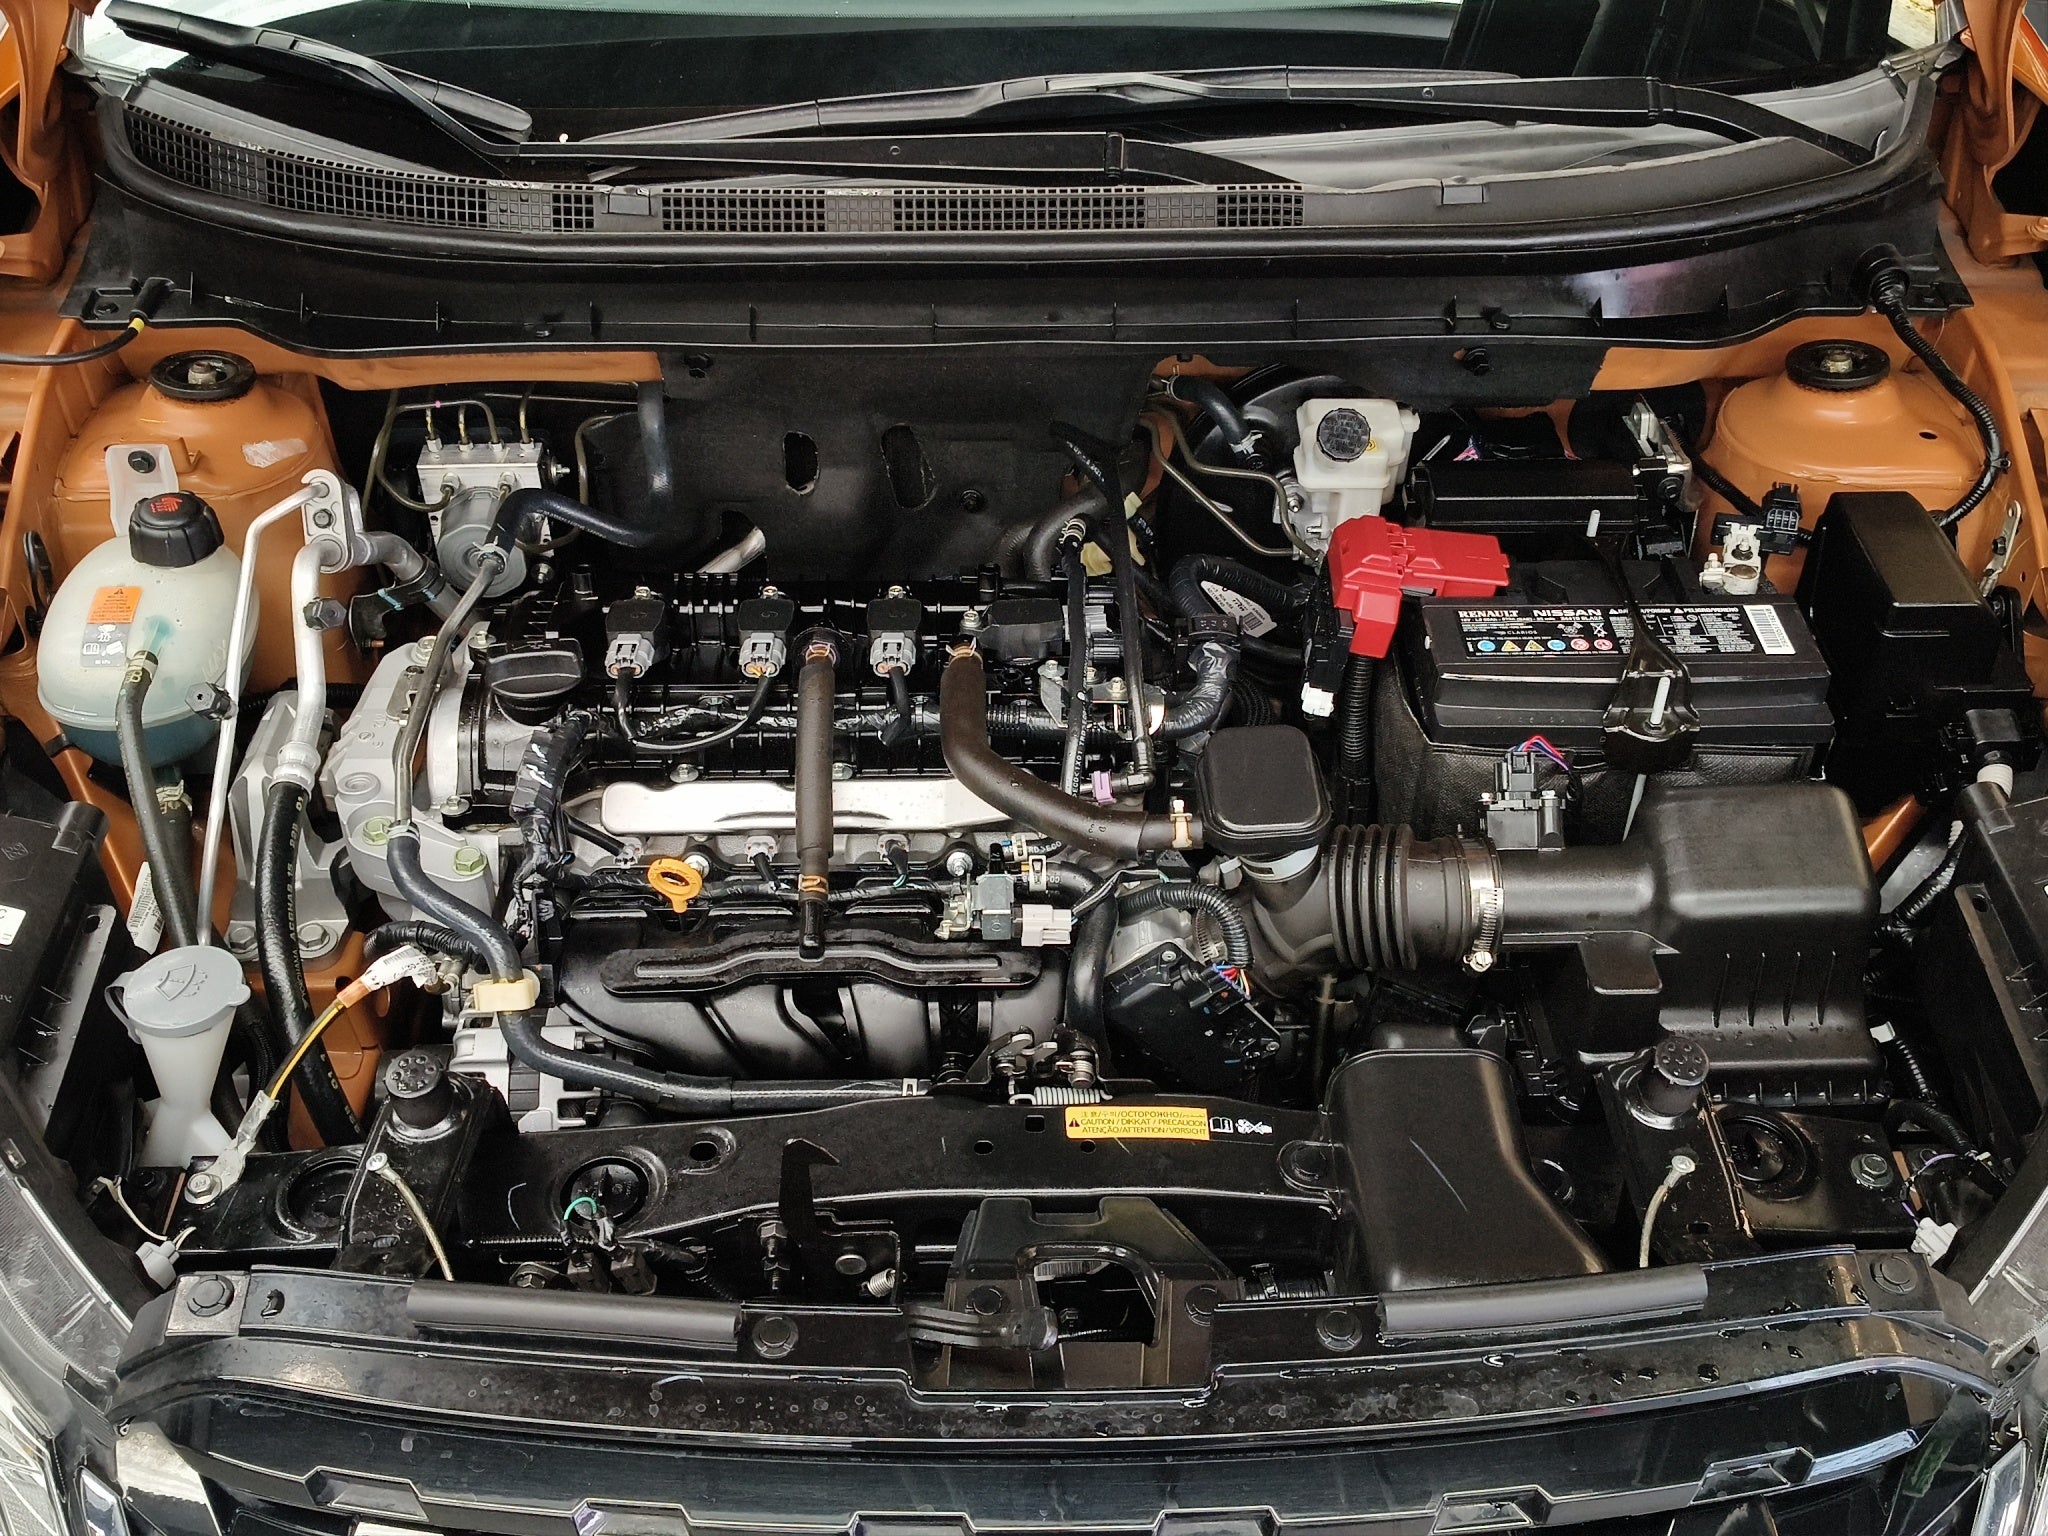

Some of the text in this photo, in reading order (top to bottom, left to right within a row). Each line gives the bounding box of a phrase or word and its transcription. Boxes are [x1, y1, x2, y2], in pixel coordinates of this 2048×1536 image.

[1458, 608, 1602, 618] RENAULT NISSAN
[294, 949, 307, 1000] YOKOHAMA
[1121, 1118, 1151, 1126] DIKKAT
